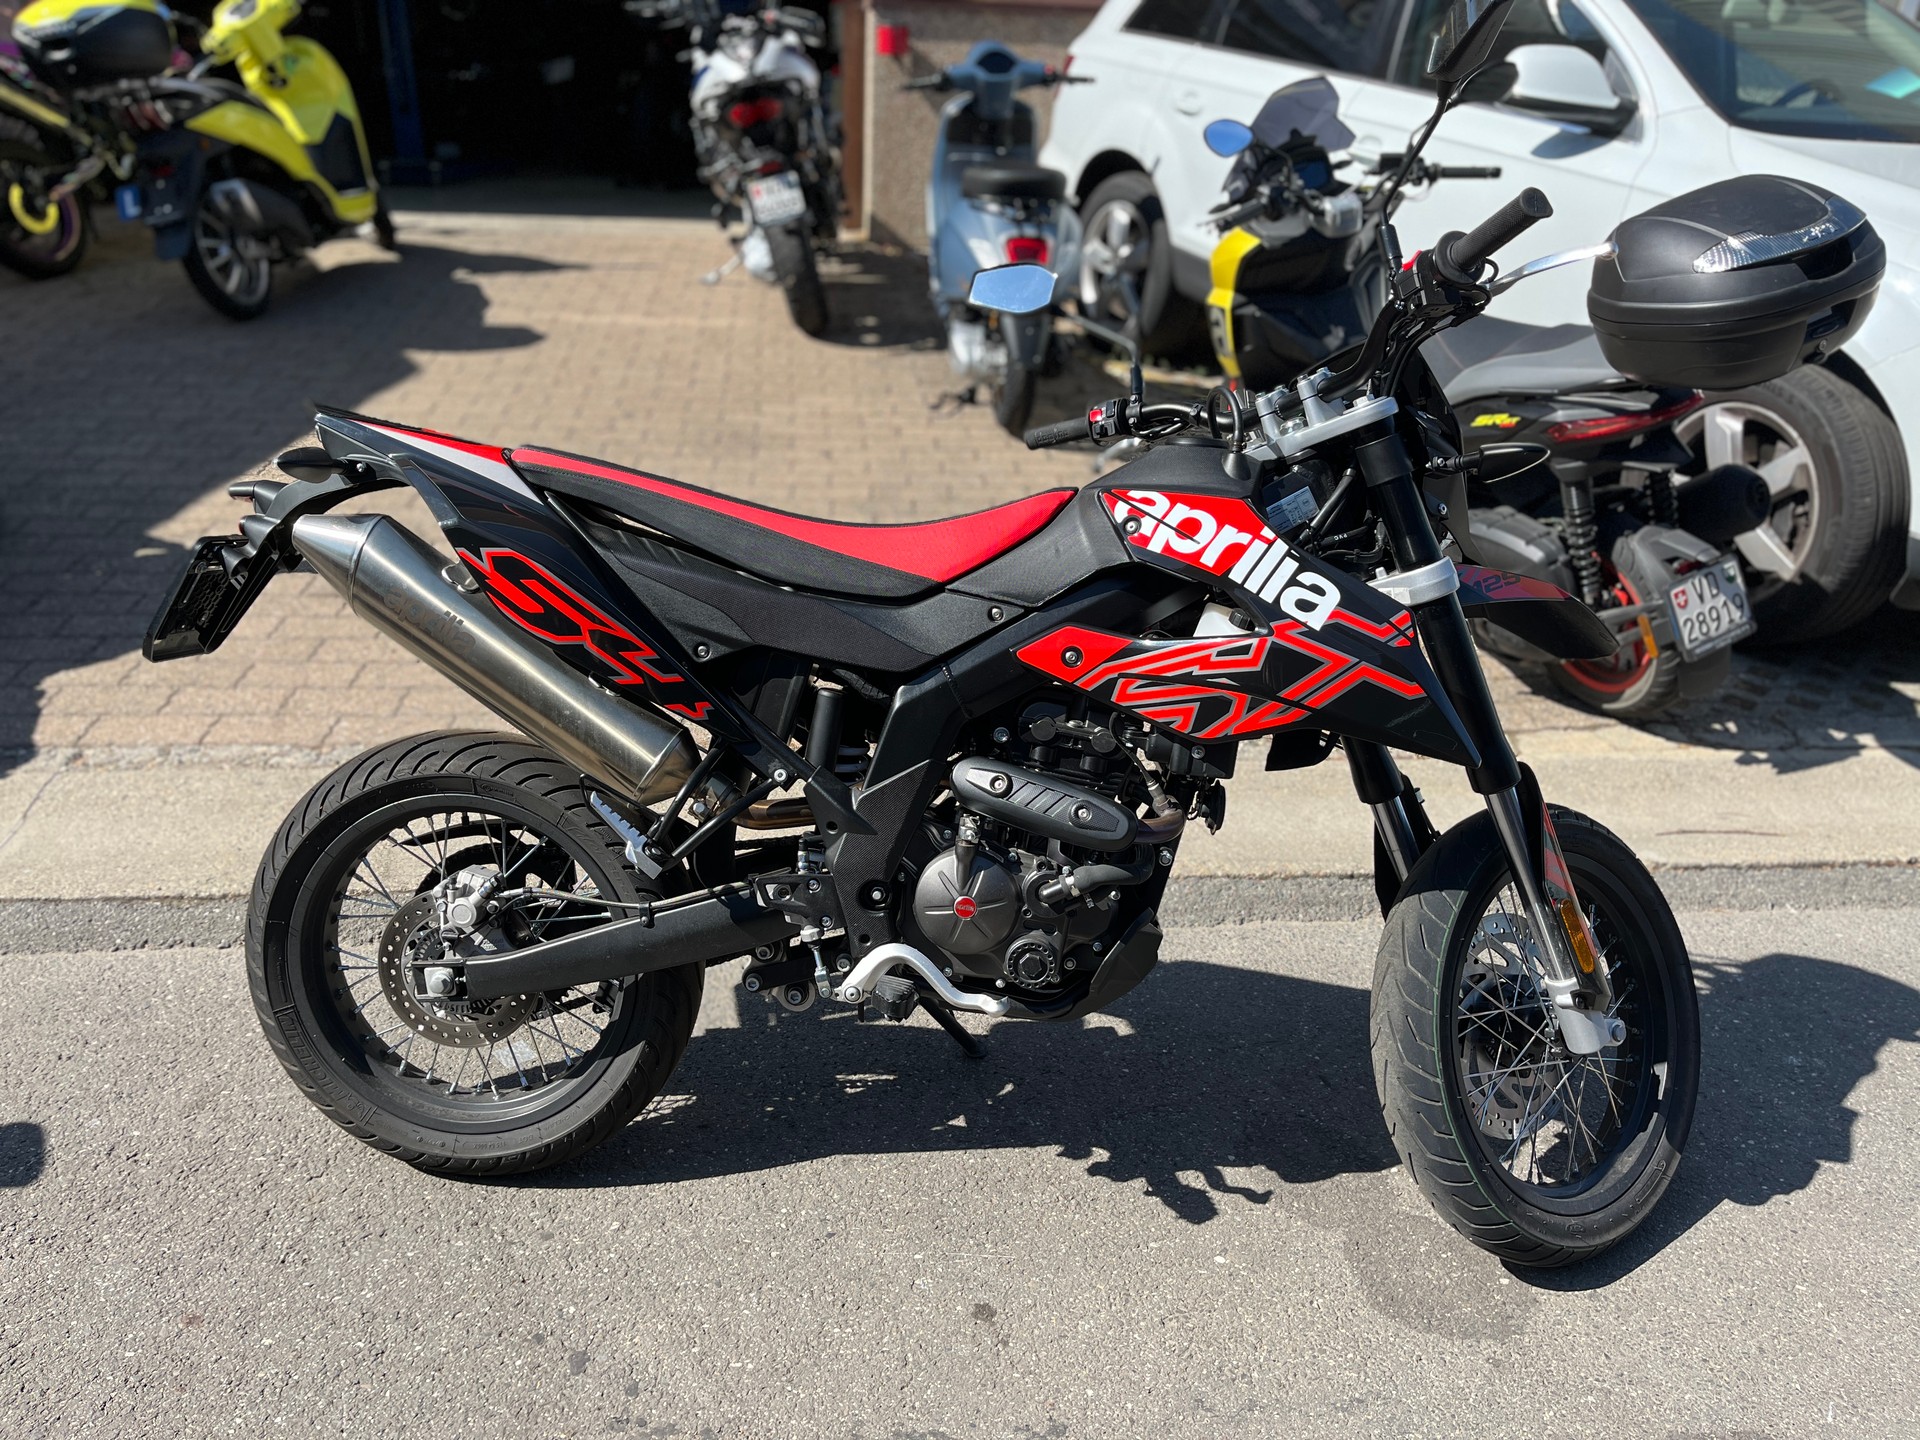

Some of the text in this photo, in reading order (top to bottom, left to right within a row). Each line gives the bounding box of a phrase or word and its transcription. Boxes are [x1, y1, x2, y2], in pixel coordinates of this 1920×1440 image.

[123, 189, 142, 217] L
[1114, 490, 1341, 631] aprilia
[1691, 571, 1720, 605] VD
[1682, 593, 1744, 642] 28919
